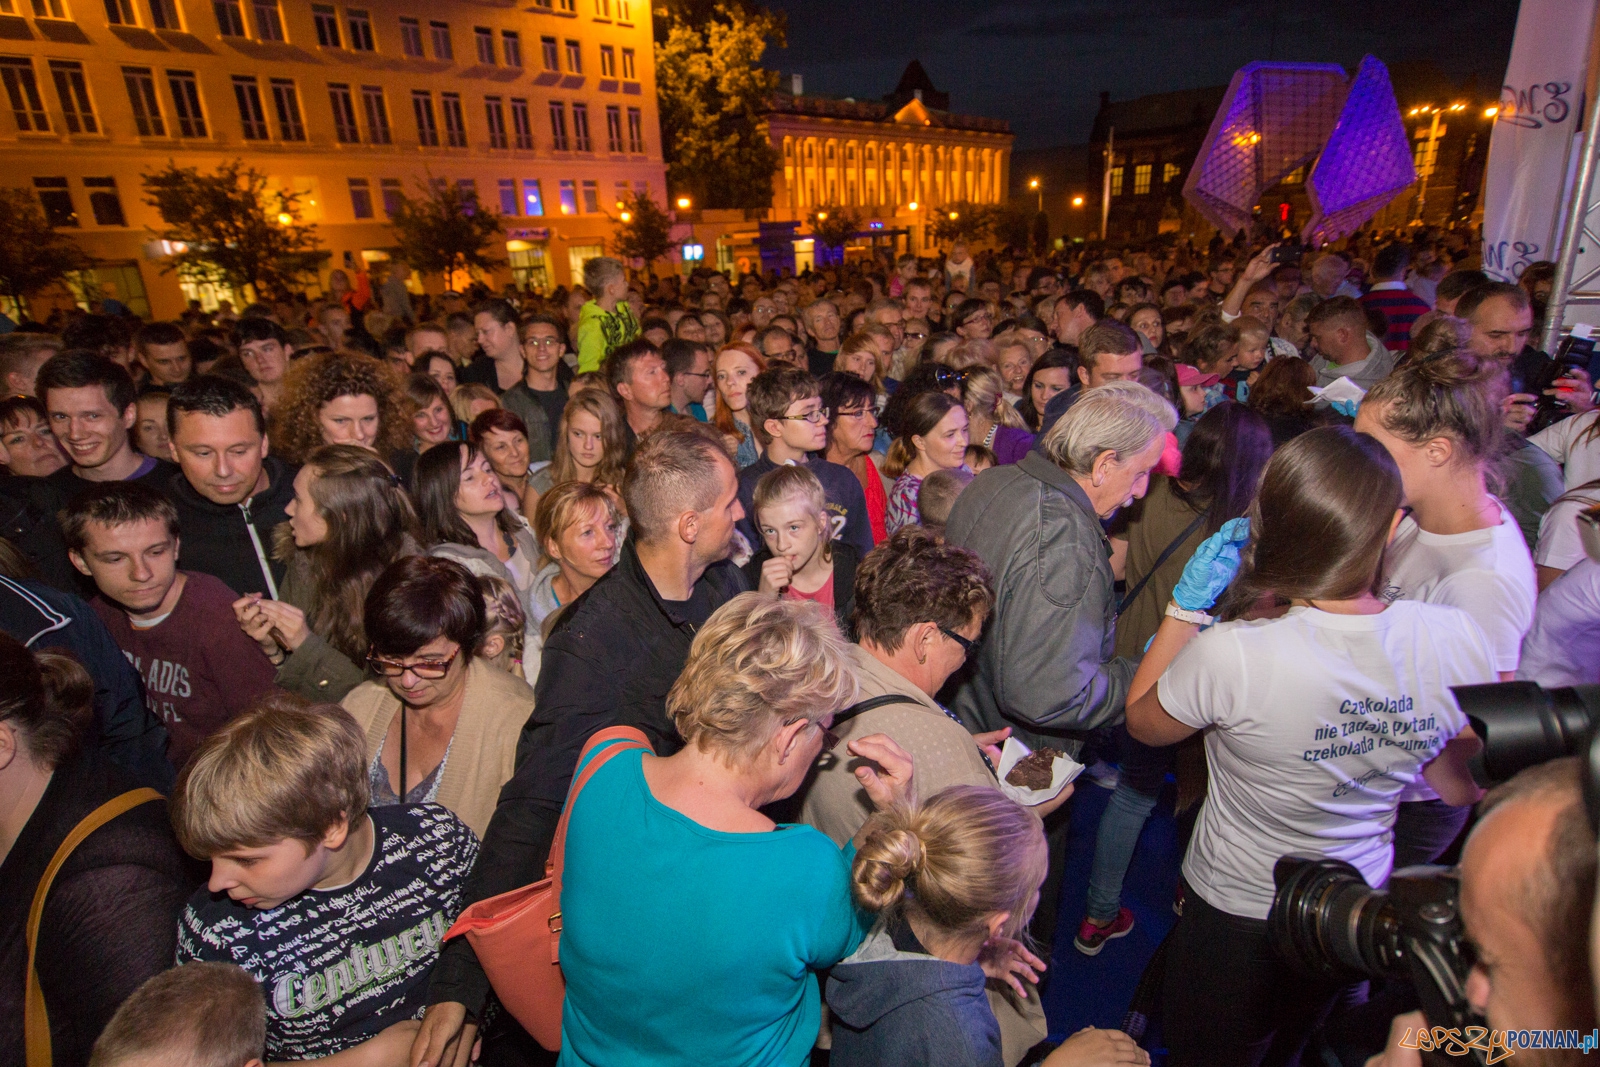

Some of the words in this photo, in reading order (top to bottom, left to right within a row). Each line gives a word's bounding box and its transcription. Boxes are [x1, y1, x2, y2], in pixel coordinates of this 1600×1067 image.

[1339, 694, 1414, 716] Czekolada
[1314, 723, 1338, 741] nie
[1341, 718, 1389, 738] zadaje
[1393, 713, 1440, 737] pytań,
[1303, 736, 1374, 762] czekolada
